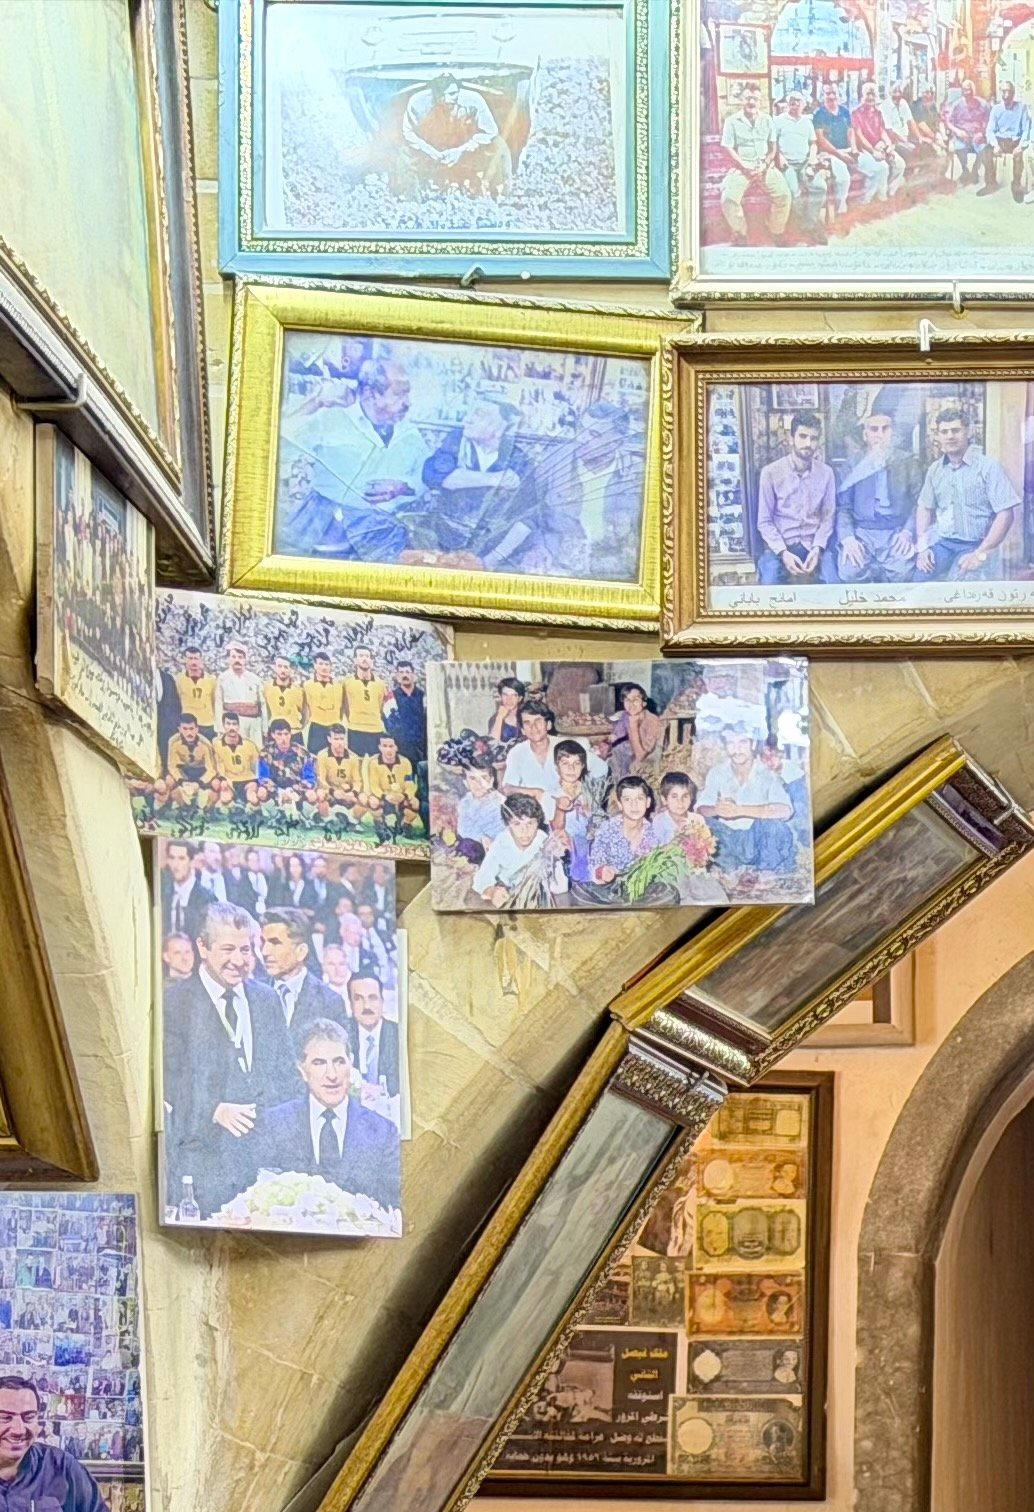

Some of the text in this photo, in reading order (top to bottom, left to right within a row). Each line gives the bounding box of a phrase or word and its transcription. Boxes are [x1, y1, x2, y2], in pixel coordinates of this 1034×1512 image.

[872, 591, 907, 603] محمد
[192, 687, 202, 699] 17
[231, 754, 242, 766] 16
[336, 768, 347, 779] 15
